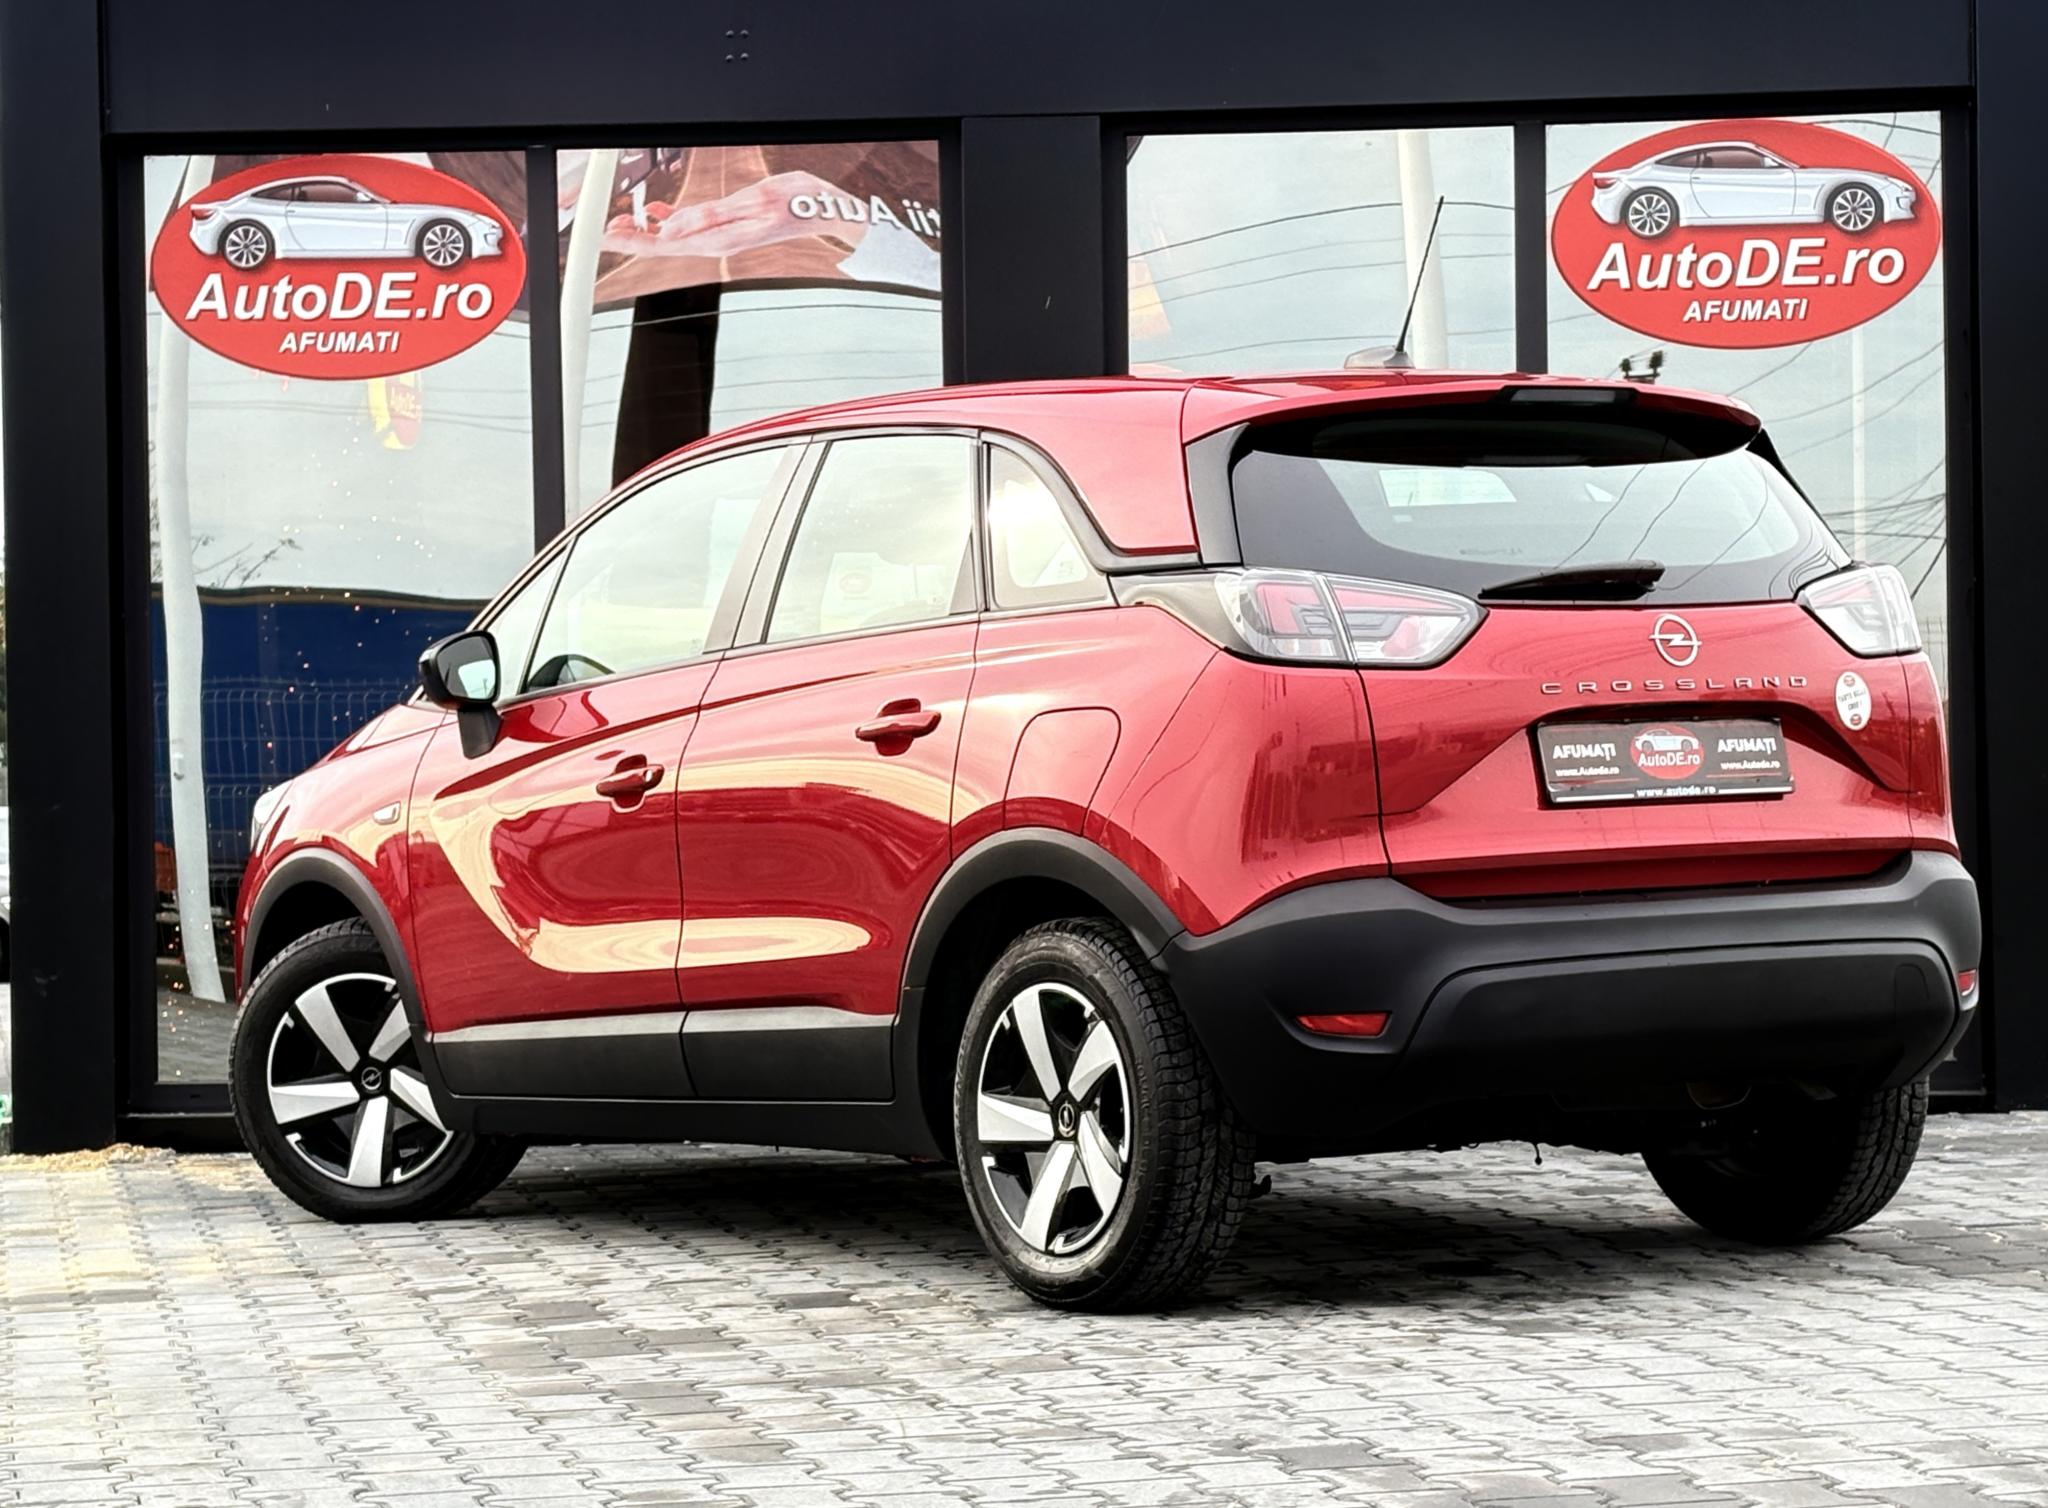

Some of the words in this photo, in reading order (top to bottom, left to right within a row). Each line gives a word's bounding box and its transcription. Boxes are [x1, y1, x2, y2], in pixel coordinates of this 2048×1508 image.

[1587, 237, 1907, 292] AutoDE.ro
[185, 272, 494, 321] AutoDE.ro
[1683, 298, 1809, 323] AFUMATI
[278, 330, 401, 354] AFUMATI
[1541, 675, 1809, 695] CROSSLAND
[1638, 751, 1700, 767] AutoDE.ro
